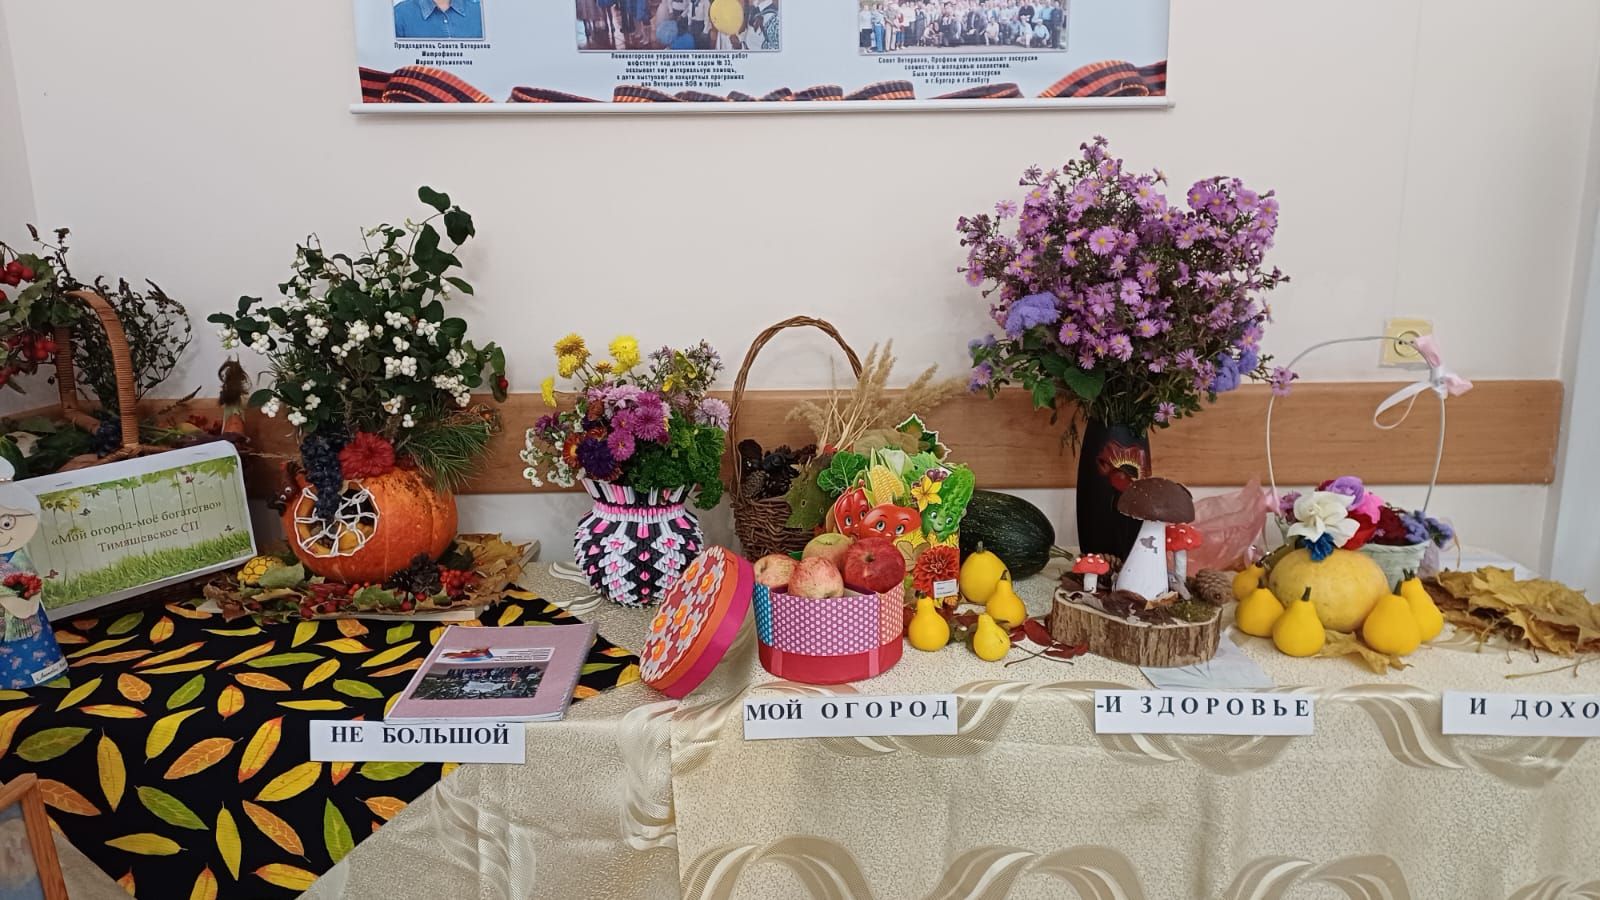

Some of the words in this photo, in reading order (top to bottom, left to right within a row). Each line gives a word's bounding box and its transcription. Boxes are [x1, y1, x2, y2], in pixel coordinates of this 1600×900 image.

[51, 532, 88, 546] «Мой
[161, 500, 223, 521] богатство»
[97, 529, 178, 553] Тимяшевское
[180, 520, 201, 532] СП
[746, 699, 803, 721] МОЙ
[821, 700, 950, 720] ОГОРОД
[1140, 695, 1310, 717] ЗДОРОВЬЕ
[1470, 697, 1487, 715] И
[331, 726, 364, 743] НЕ
[382, 723, 510, 745] БОЛЬШОЙ
